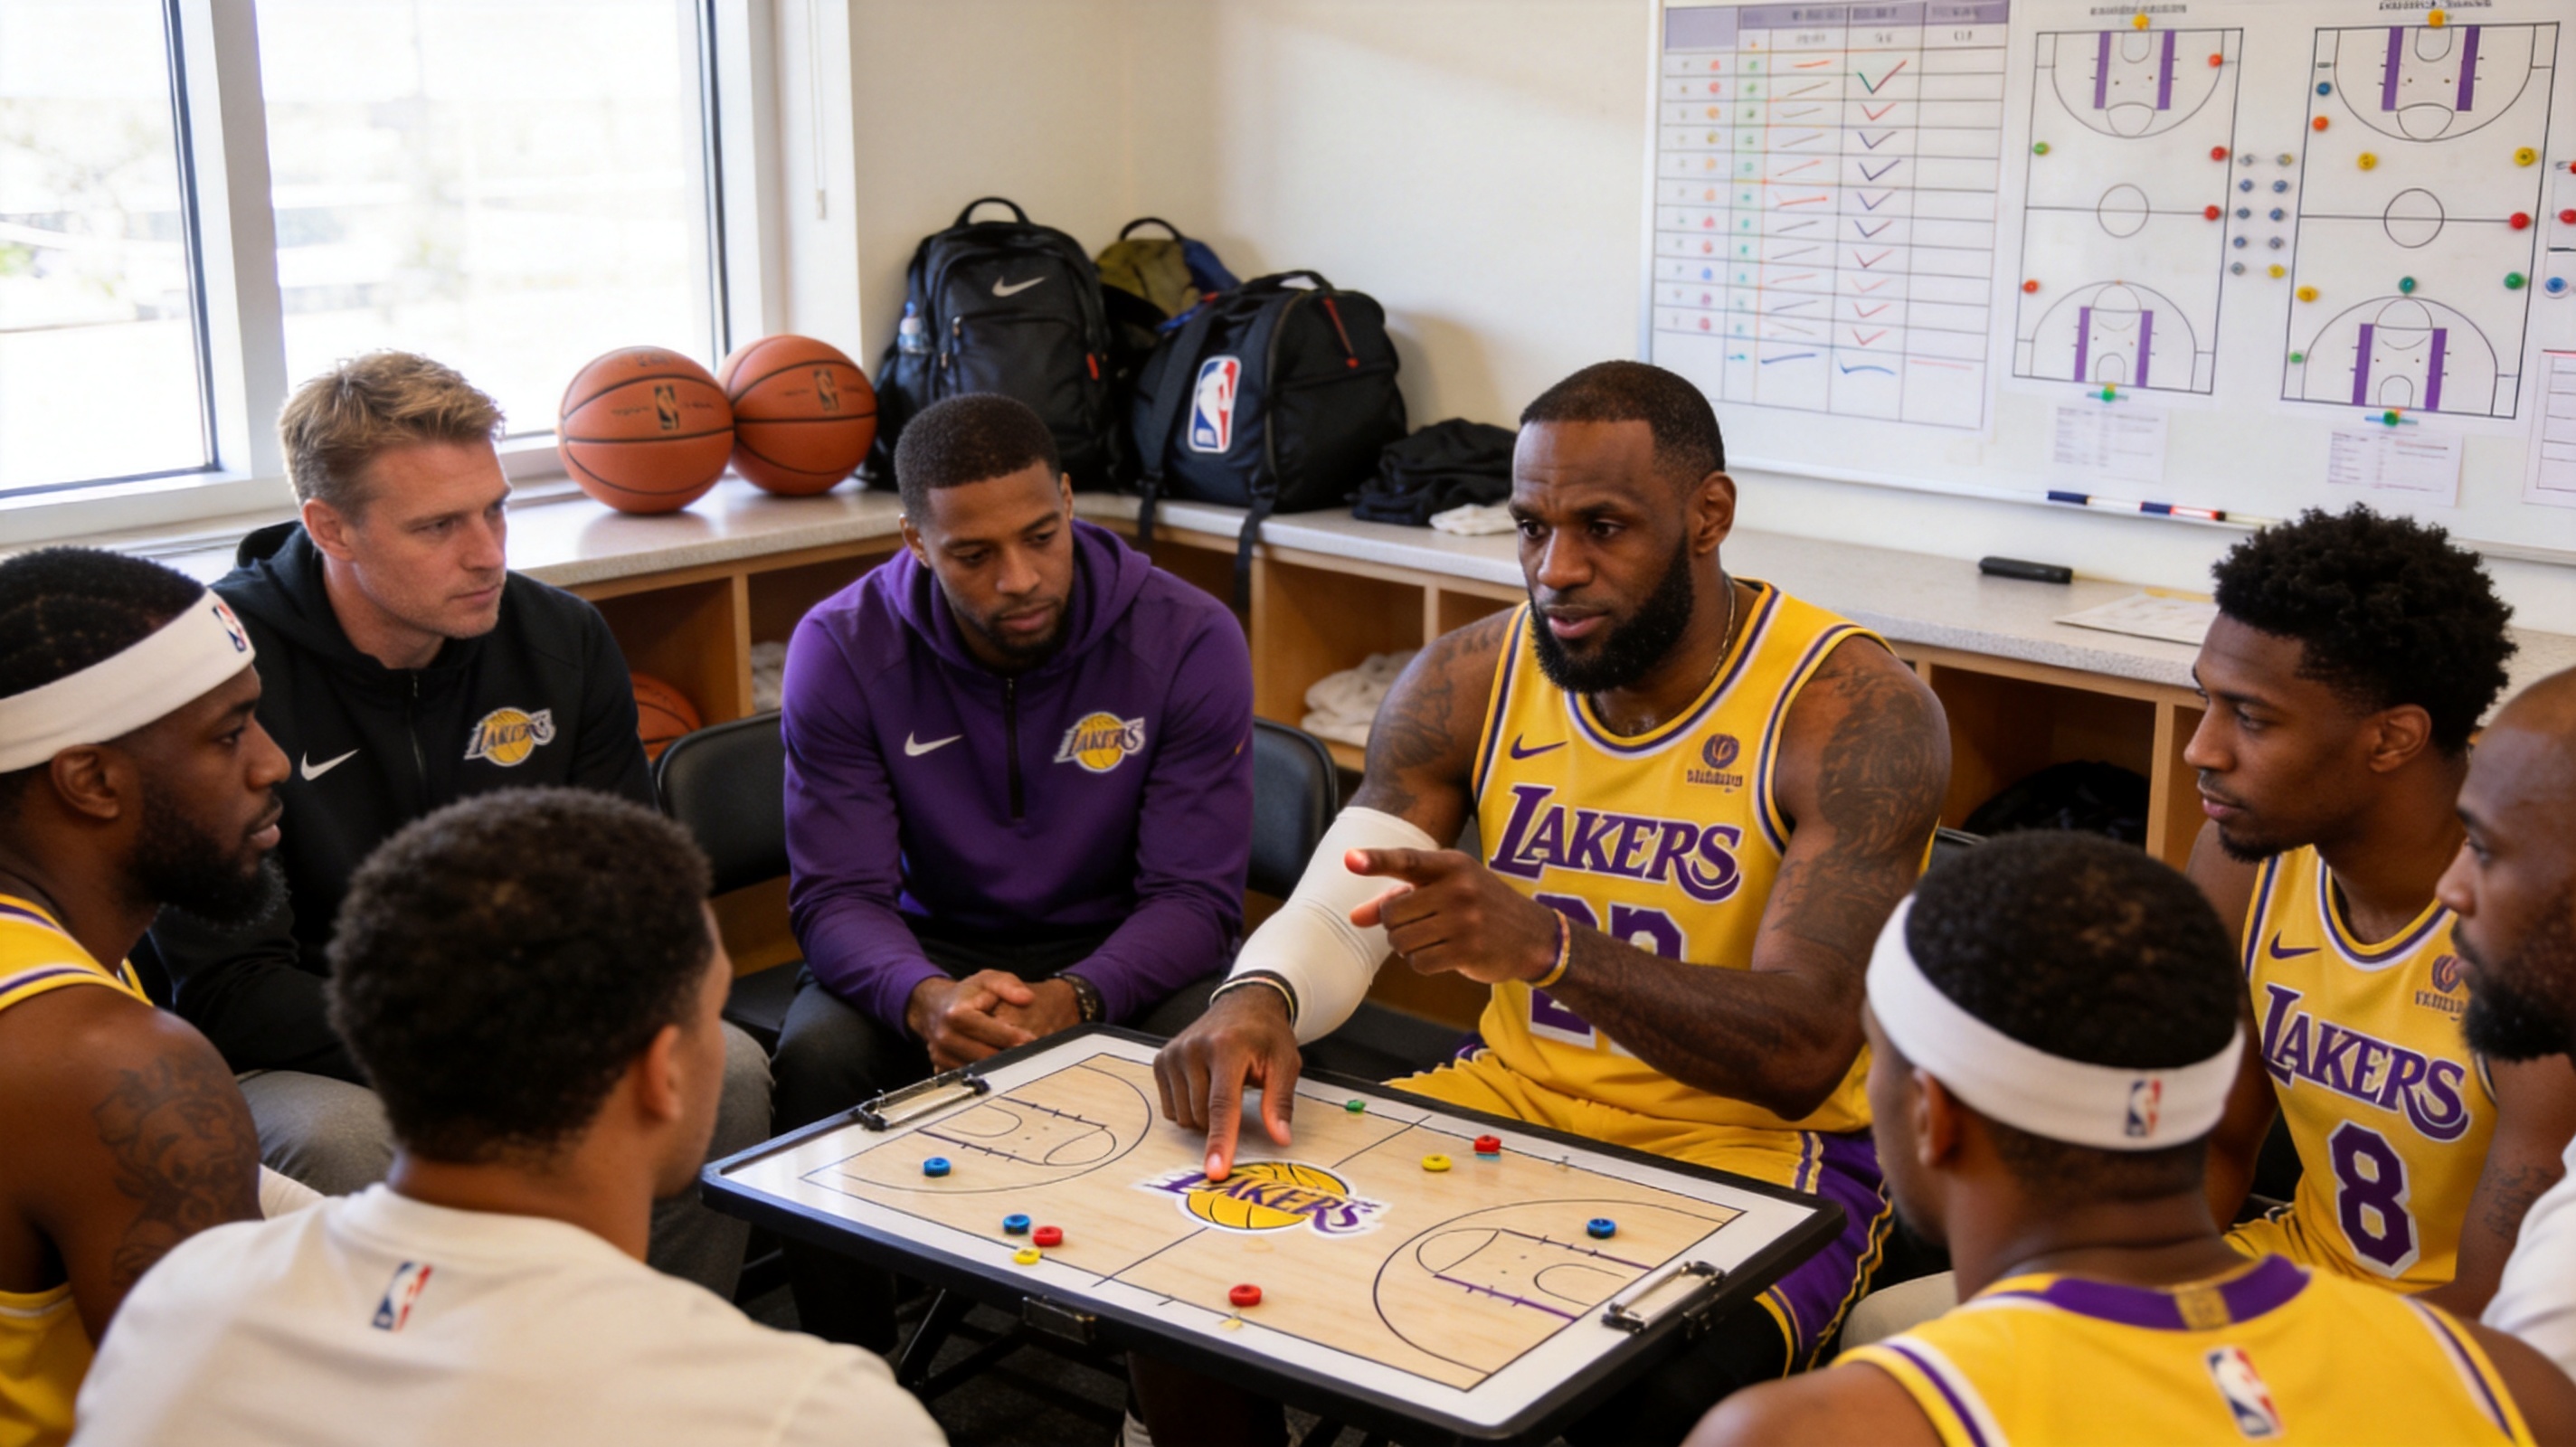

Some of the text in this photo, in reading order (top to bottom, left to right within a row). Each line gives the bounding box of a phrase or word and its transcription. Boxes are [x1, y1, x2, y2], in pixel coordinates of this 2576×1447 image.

[1487, 783, 1743, 904] LAKERS
[2260, 980, 2473, 1143] LAKERS
[2327, 1119, 2420, 1280] 8
